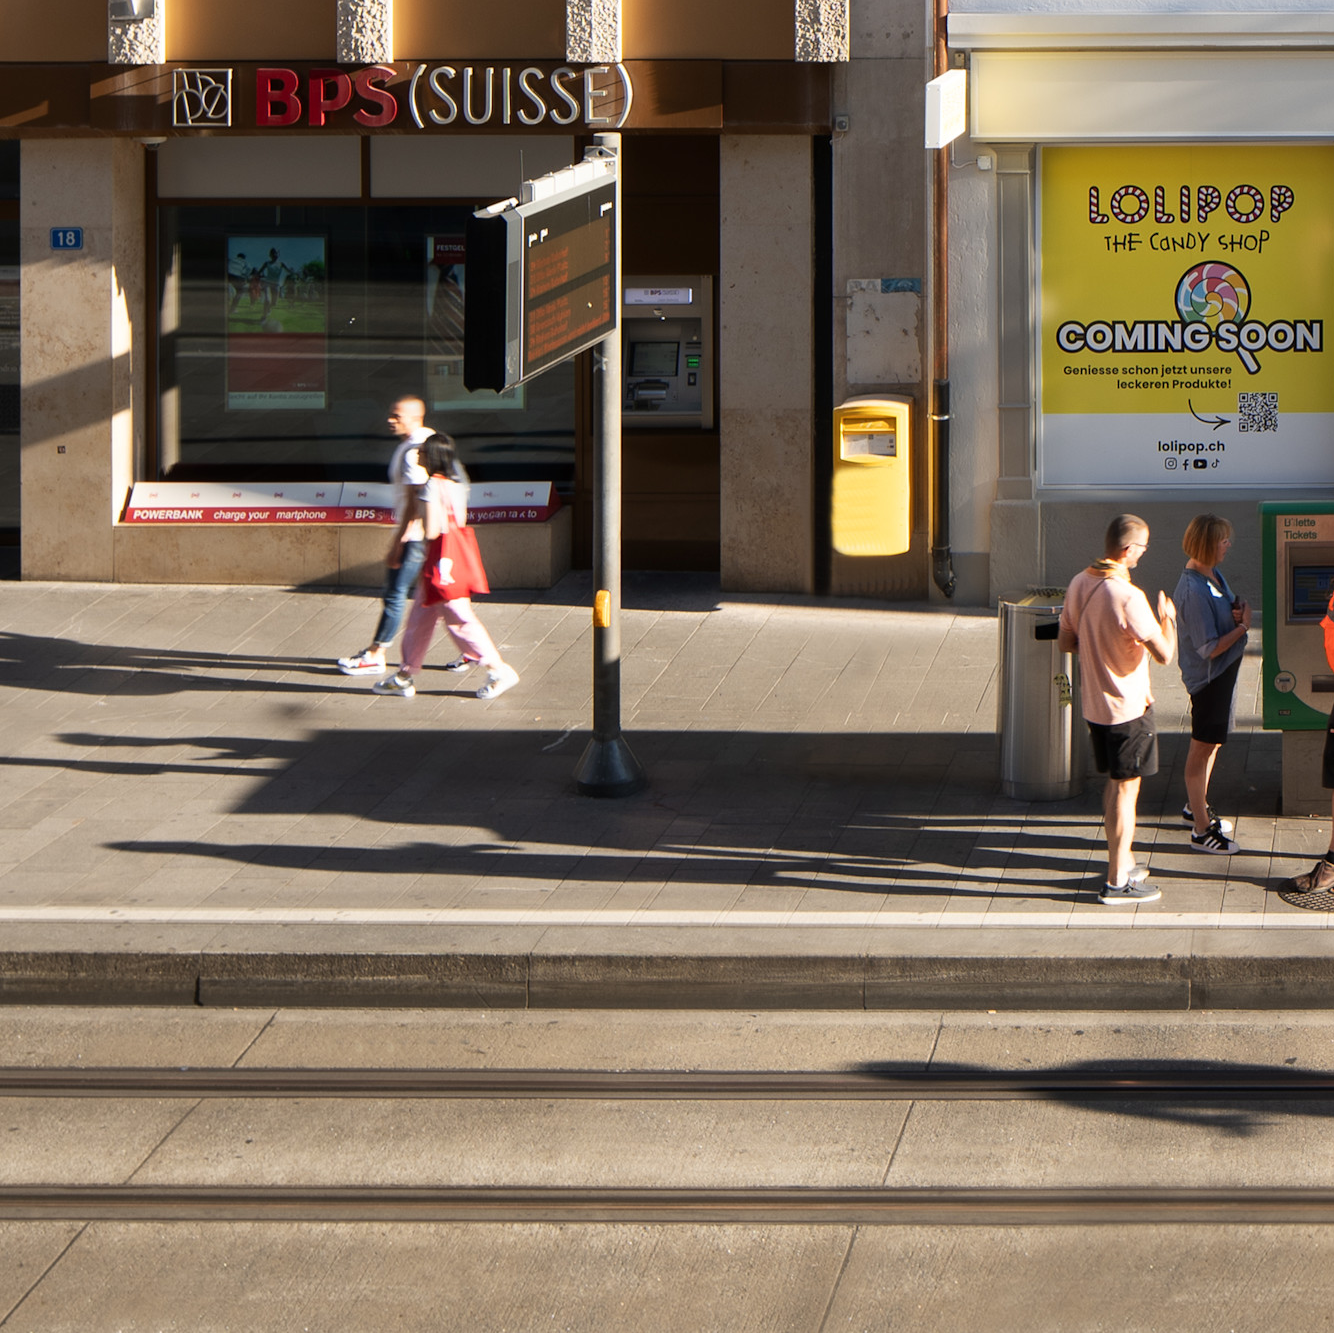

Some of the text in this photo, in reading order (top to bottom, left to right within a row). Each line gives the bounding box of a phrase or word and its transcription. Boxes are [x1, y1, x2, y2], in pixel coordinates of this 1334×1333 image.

[255, 62, 635, 129] BPS (SUISSE)
[1088, 184, 1295, 224] LOLIPOP
[57, 231, 76, 247] 18
[1104, 232, 1143, 253] THE
[1217, 229, 1270, 254] SHOP
[436, 244, 465, 252] FESTGEL
[1056, 319, 1324, 353] COMING SOON
[1063, 365, 1232, 377] Geniesse schon jetzt unsere
[1116, 379, 1232, 390] leckeren Produkte!
[1157, 439, 1226, 455] lolipop.ch
[132, 509, 203, 520] POWERBANK
[213, 509, 246, 522] charge
[247, 511, 270, 522] your
[355, 508, 376, 520] BPS
[527, 509, 537, 519] to
[1283, 530, 1318, 540] Tickets
